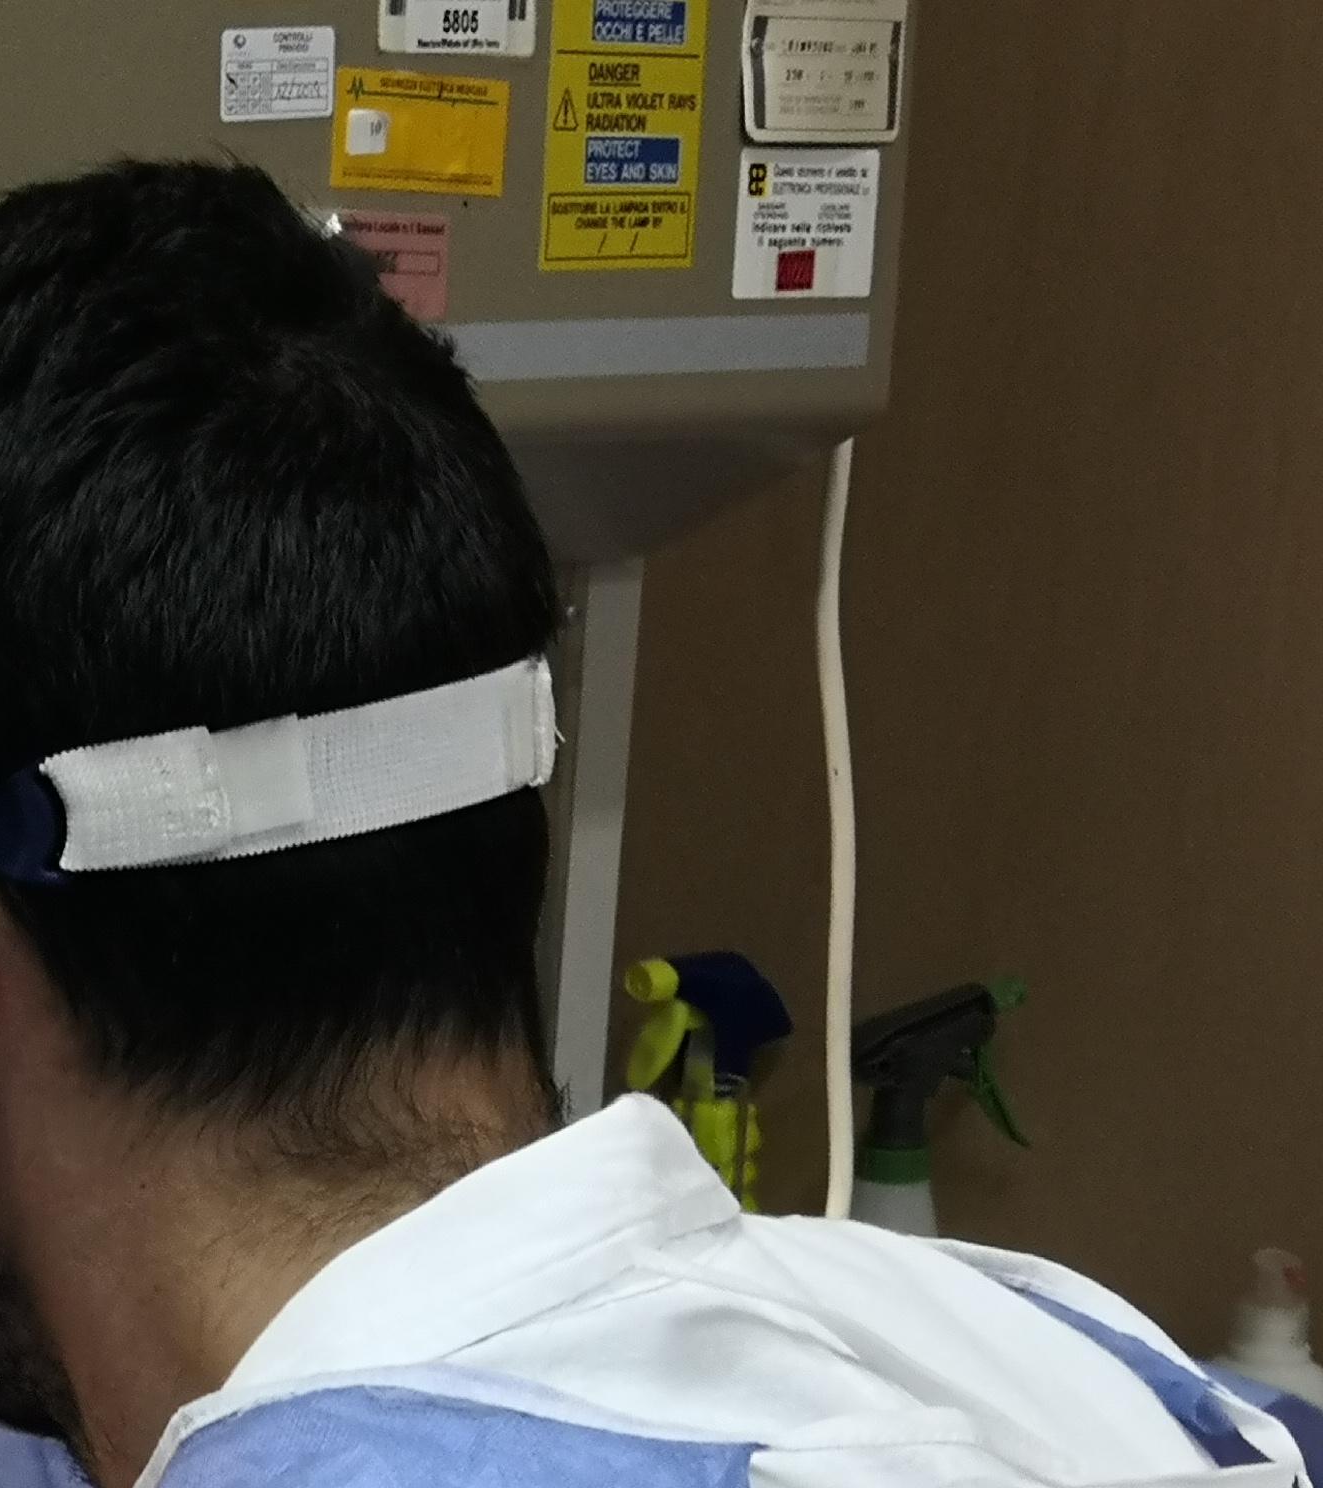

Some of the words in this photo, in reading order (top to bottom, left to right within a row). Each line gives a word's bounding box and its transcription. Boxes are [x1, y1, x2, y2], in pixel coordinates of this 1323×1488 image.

[596, 0, 673, 19] PROTEGGERE
[442, 9, 479, 34] 5805
[594, 21, 632, 40] OCCHI
[636, 22, 645, 41] E
[648, 23, 684, 42] PELLE
[588, 63, 640, 81] DANGER
[586, 92, 622, 110] ULTRA
[625, 93, 665, 110] VIOLET
[667, 94, 697, 111] RAYS
[585, 113, 648, 132] RADIATION
[587, 139, 641, 158] PROTECT
[586, 162, 618, 180] EYES
[620, 163, 646, 181] AND
[648, 163, 678, 181] SKIN
